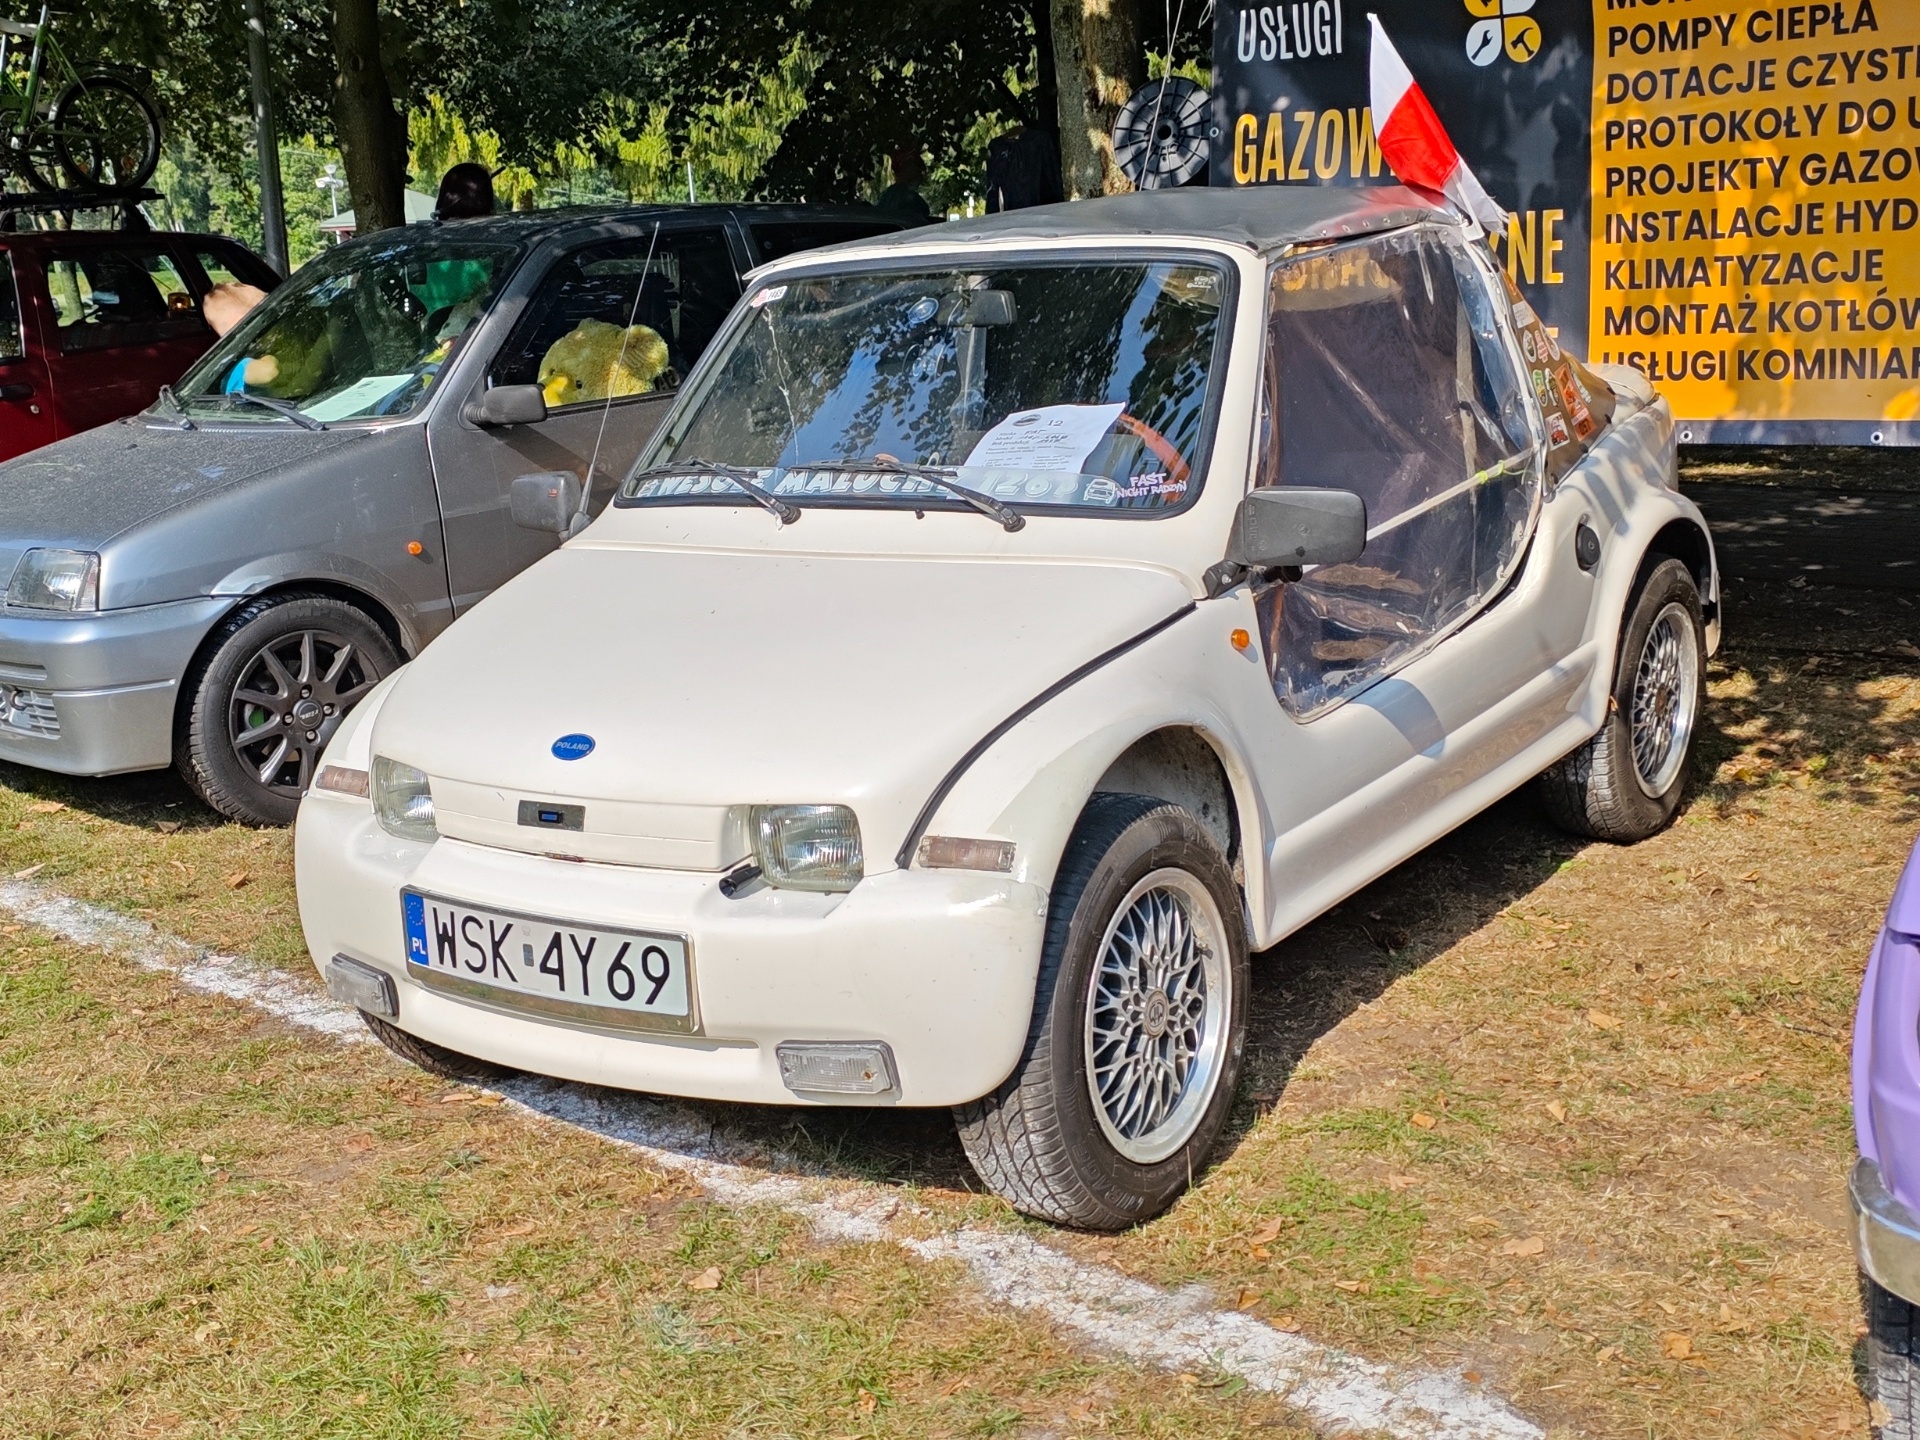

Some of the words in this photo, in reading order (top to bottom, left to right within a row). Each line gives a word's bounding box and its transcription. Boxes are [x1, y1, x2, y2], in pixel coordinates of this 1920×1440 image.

[1237, 0, 1343, 62] USŁUGI
[1608, 13, 1737, 58] POMPY
[1746, 0, 1879, 44] CIEPŁA
[1606, 58, 1777, 105] DOTACJE
[1234, 106, 1396, 185] GAZOW
[1605, 103, 1828, 152] PROTOKOŁY
[1838, 98, 1897, 136] DO
[1605, 155, 1790, 199] PROJEKTY
[1799, 146, 1920, 187] GAZO
[1605, 202, 1825, 245] INSTALACJE
[1835, 197, 1919, 234] HYD
[1605, 249, 1884, 291] KLIMATYZACJE
[1604, 292, 1758, 337] MONTAŻ
[1115, 486, 1150, 499] NIGHT
[1129, 472, 1167, 487] FAST
[554, 741, 590, 751] POLAND
[411, 936, 427, 955] PL
[432, 907, 518, 983] WSK
[539, 931, 670, 1005] 4Y69
